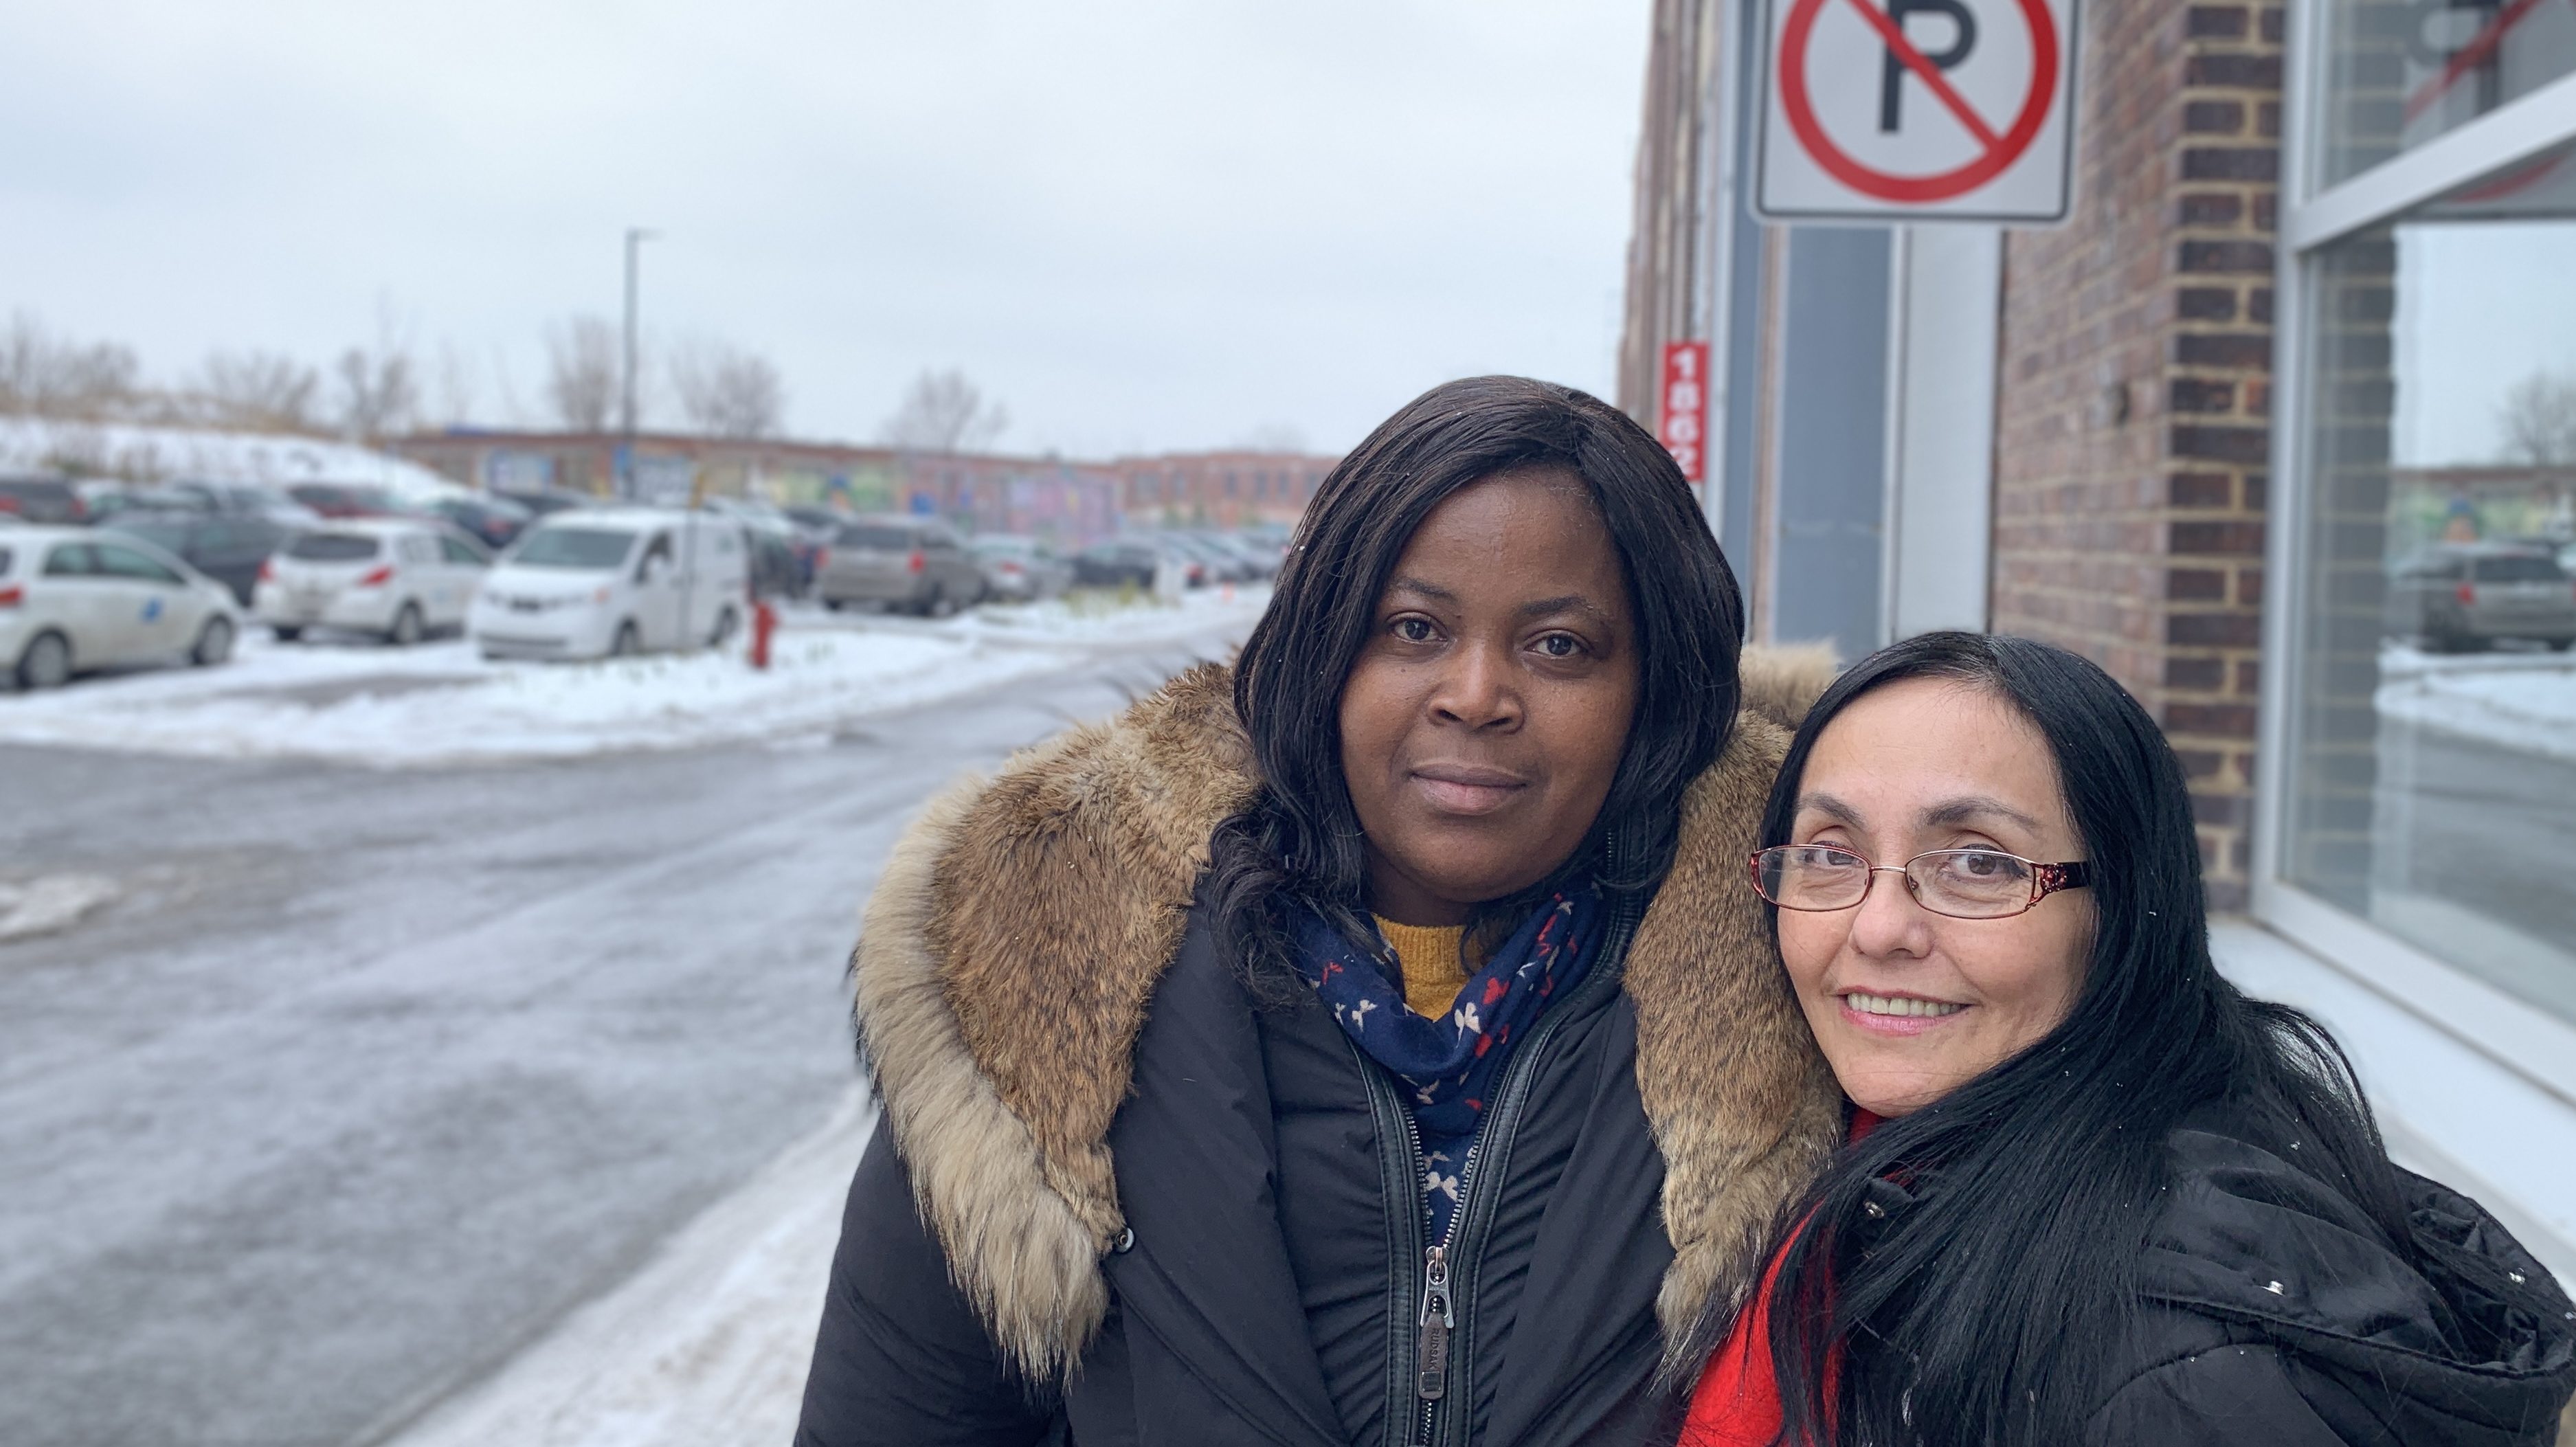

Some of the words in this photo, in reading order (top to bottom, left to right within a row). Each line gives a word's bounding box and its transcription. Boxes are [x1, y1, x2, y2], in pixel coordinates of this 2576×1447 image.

[1880, 0, 1978, 134] P
[1667, 348, 1701, 478] 1862
[1429, 1327, 1441, 1372] RUDSAK
